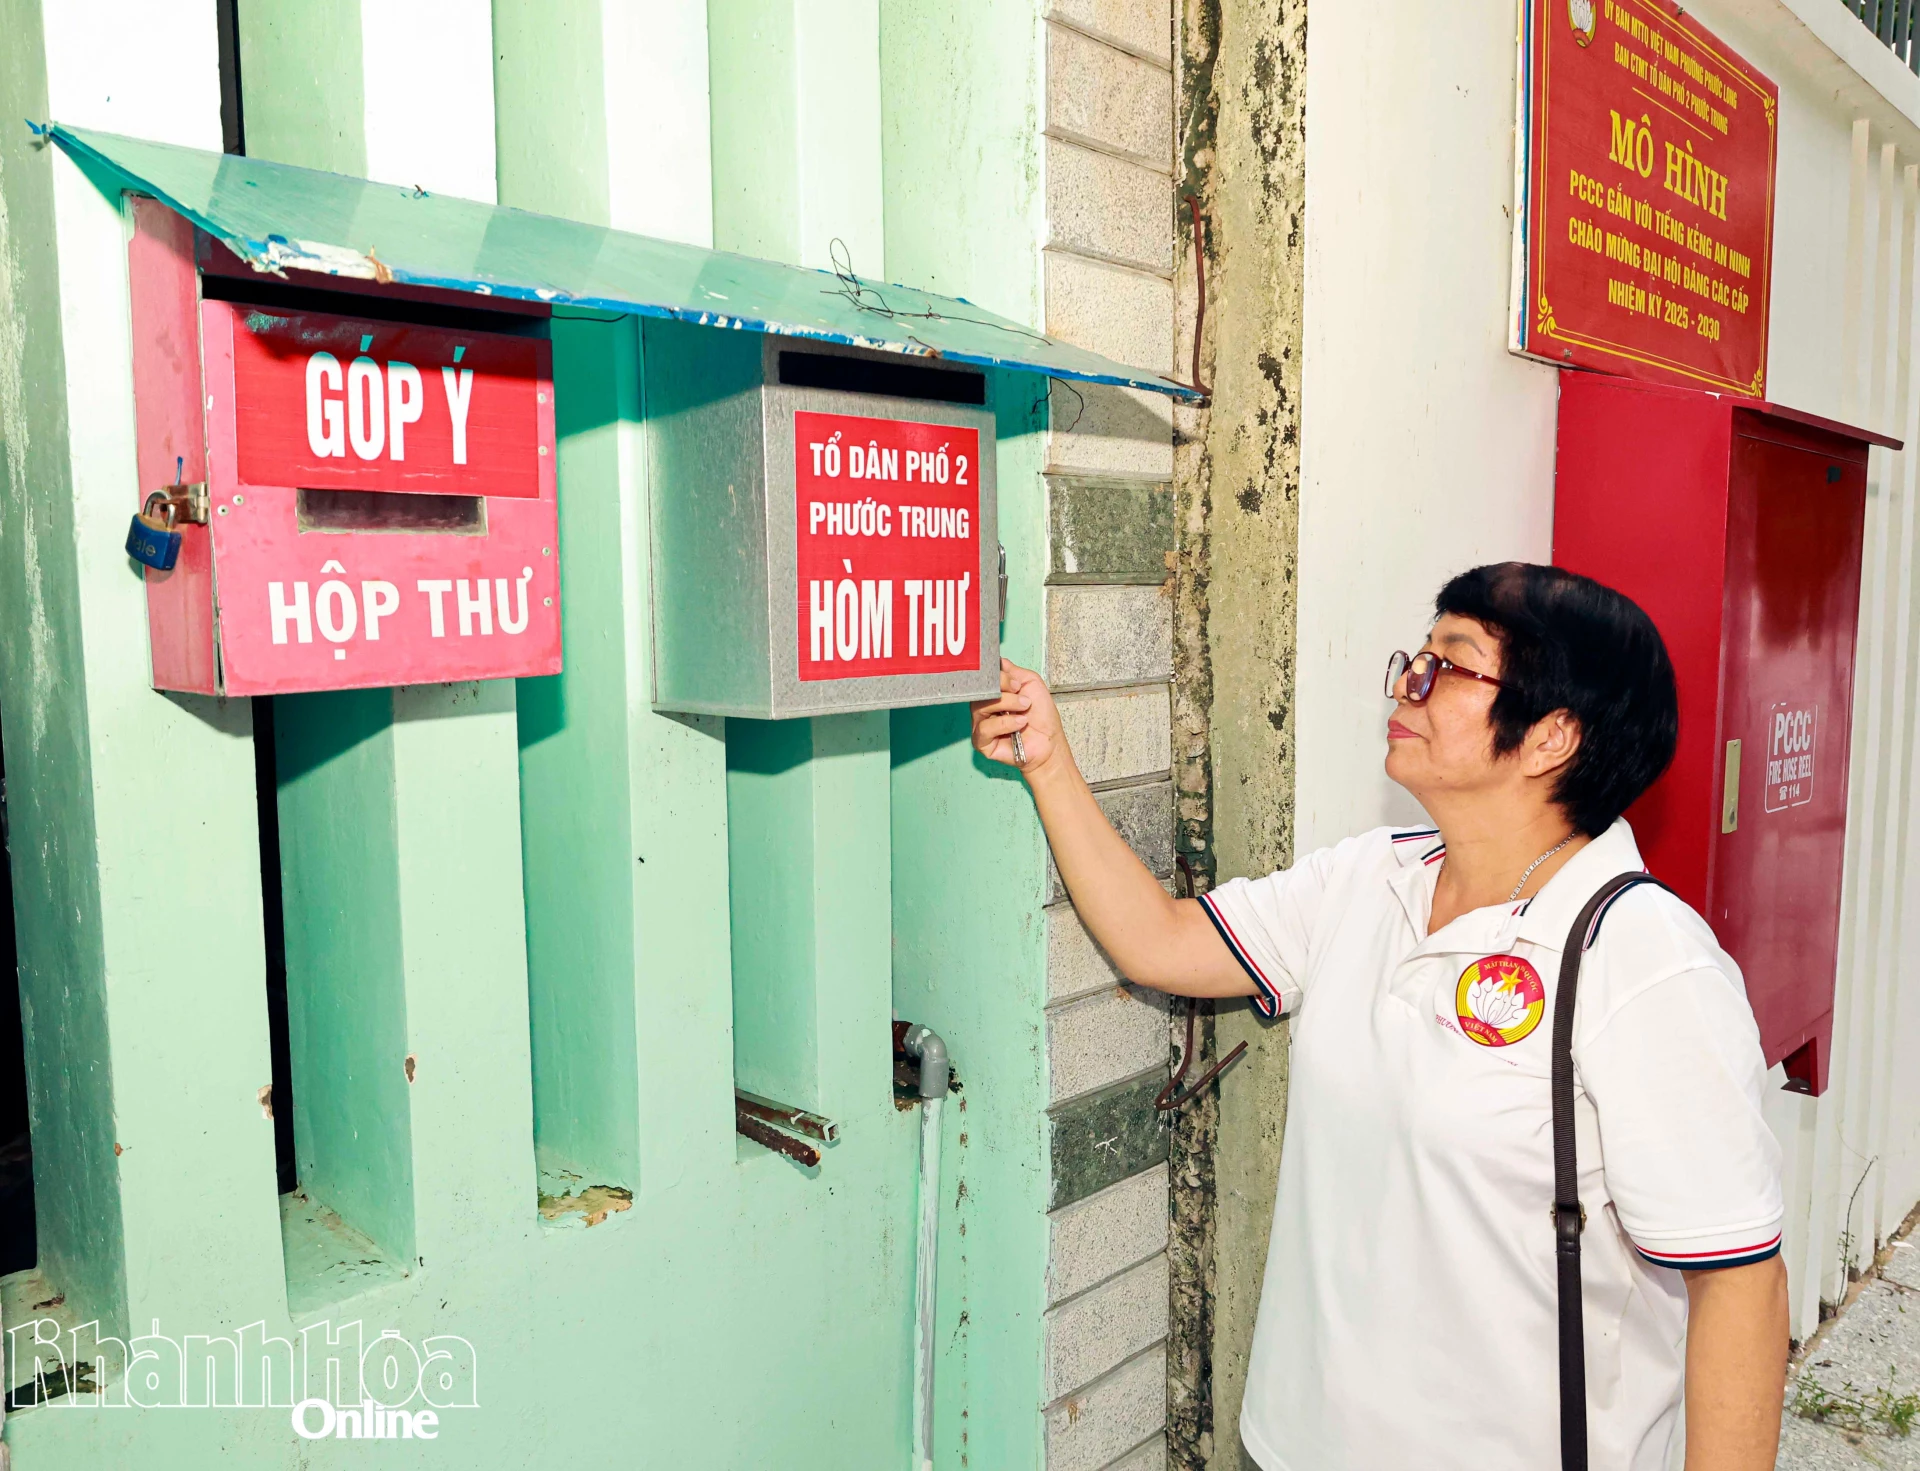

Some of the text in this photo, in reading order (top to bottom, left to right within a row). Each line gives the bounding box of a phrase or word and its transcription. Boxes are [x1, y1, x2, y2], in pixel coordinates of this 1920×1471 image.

[1614, 41, 1630, 69] BAN
[1630, 53, 1648, 81] CTMT
[1659, 70, 1671, 96] DÂN
[1672, 80, 1686, 105] PHỐ
[1685, 90, 1690, 109] 2
[1710, 107, 1728, 135] TRUNG
[1615, 5, 1630, 33] BAN
[1631, 15, 1649, 48] MTTQ
[1650, 29, 1664, 58] VIỆT
[1665, 40, 1679, 67] NAM
[1723, 84, 1737, 109] LONG
[1608, 109, 1728, 221] MÔ HÌNH
[1568, 217, 1749, 315] CHÀO MỪNG ĐẠI HỘI ĐẢNG CÁC CẤP
[1569, 169, 1751, 278] PCCC GẮN VỚI TIẾNG KẺNG AN NINH
[1608, 278, 1646, 316] NHIỆM
[1648, 291, 1663, 319] KỲ
[1664, 299, 1689, 329] 2025
[1697, 313, 1720, 341] 2030
[305, 334, 474, 465] GÓP Ý
[809, 430, 968, 485] TỔ DÂN PHỐ 2
[809, 497, 970, 539] PHƯỚC TRUNG
[267, 559, 533, 660] HỘP THƯ
[809, 559, 970, 662] HÒM THƯ
[1768, 754, 1811, 785] FIRE HOSE REEL
[1773, 710, 1812, 755] PCCC
[1789, 783, 1800, 799] 114
[1464, 1021, 1498, 1043] VIỆT NAM
